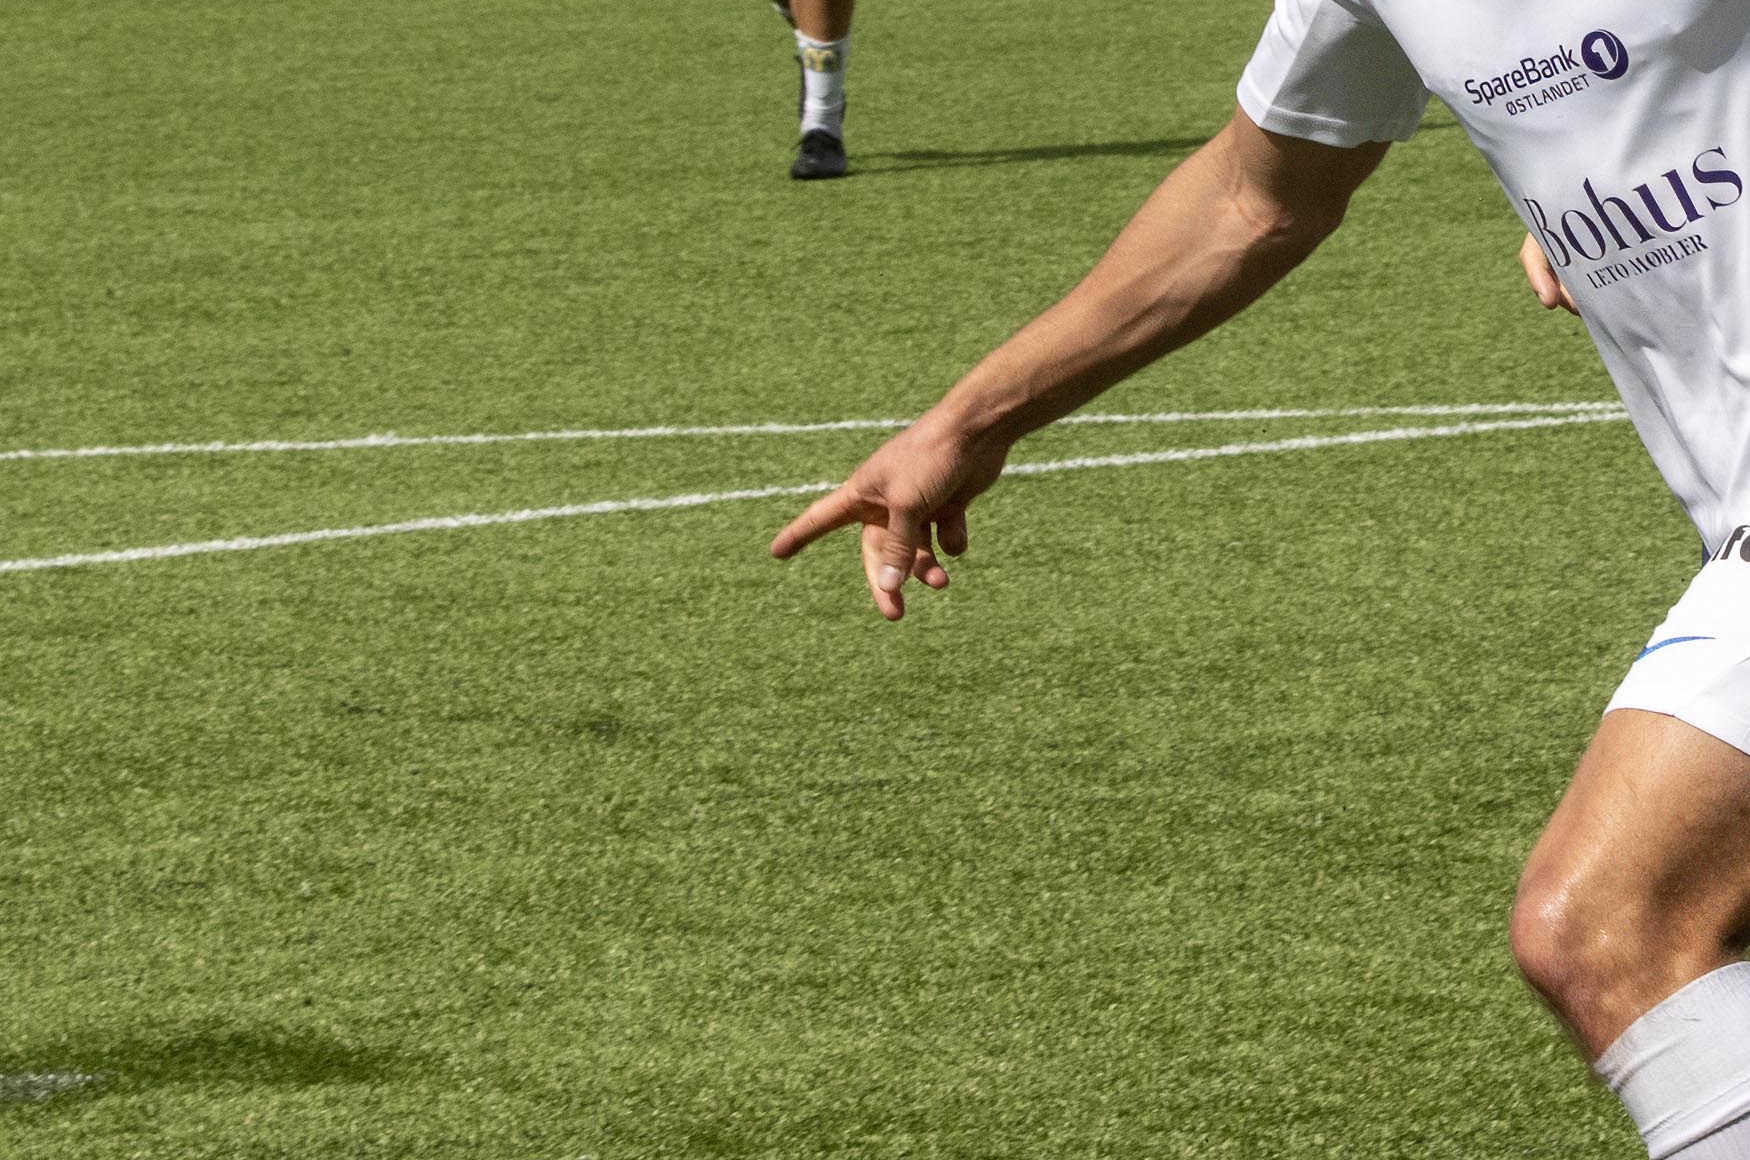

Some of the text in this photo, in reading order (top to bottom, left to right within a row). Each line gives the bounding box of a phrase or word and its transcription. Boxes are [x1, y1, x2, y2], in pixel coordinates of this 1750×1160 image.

[1464, 44, 1581, 106] SpareBank
[1505, 73, 1590, 116] ØSTLANDET
[1523, 146, 1743, 268] Bohus
[1586, 262, 1630, 290] LETO
